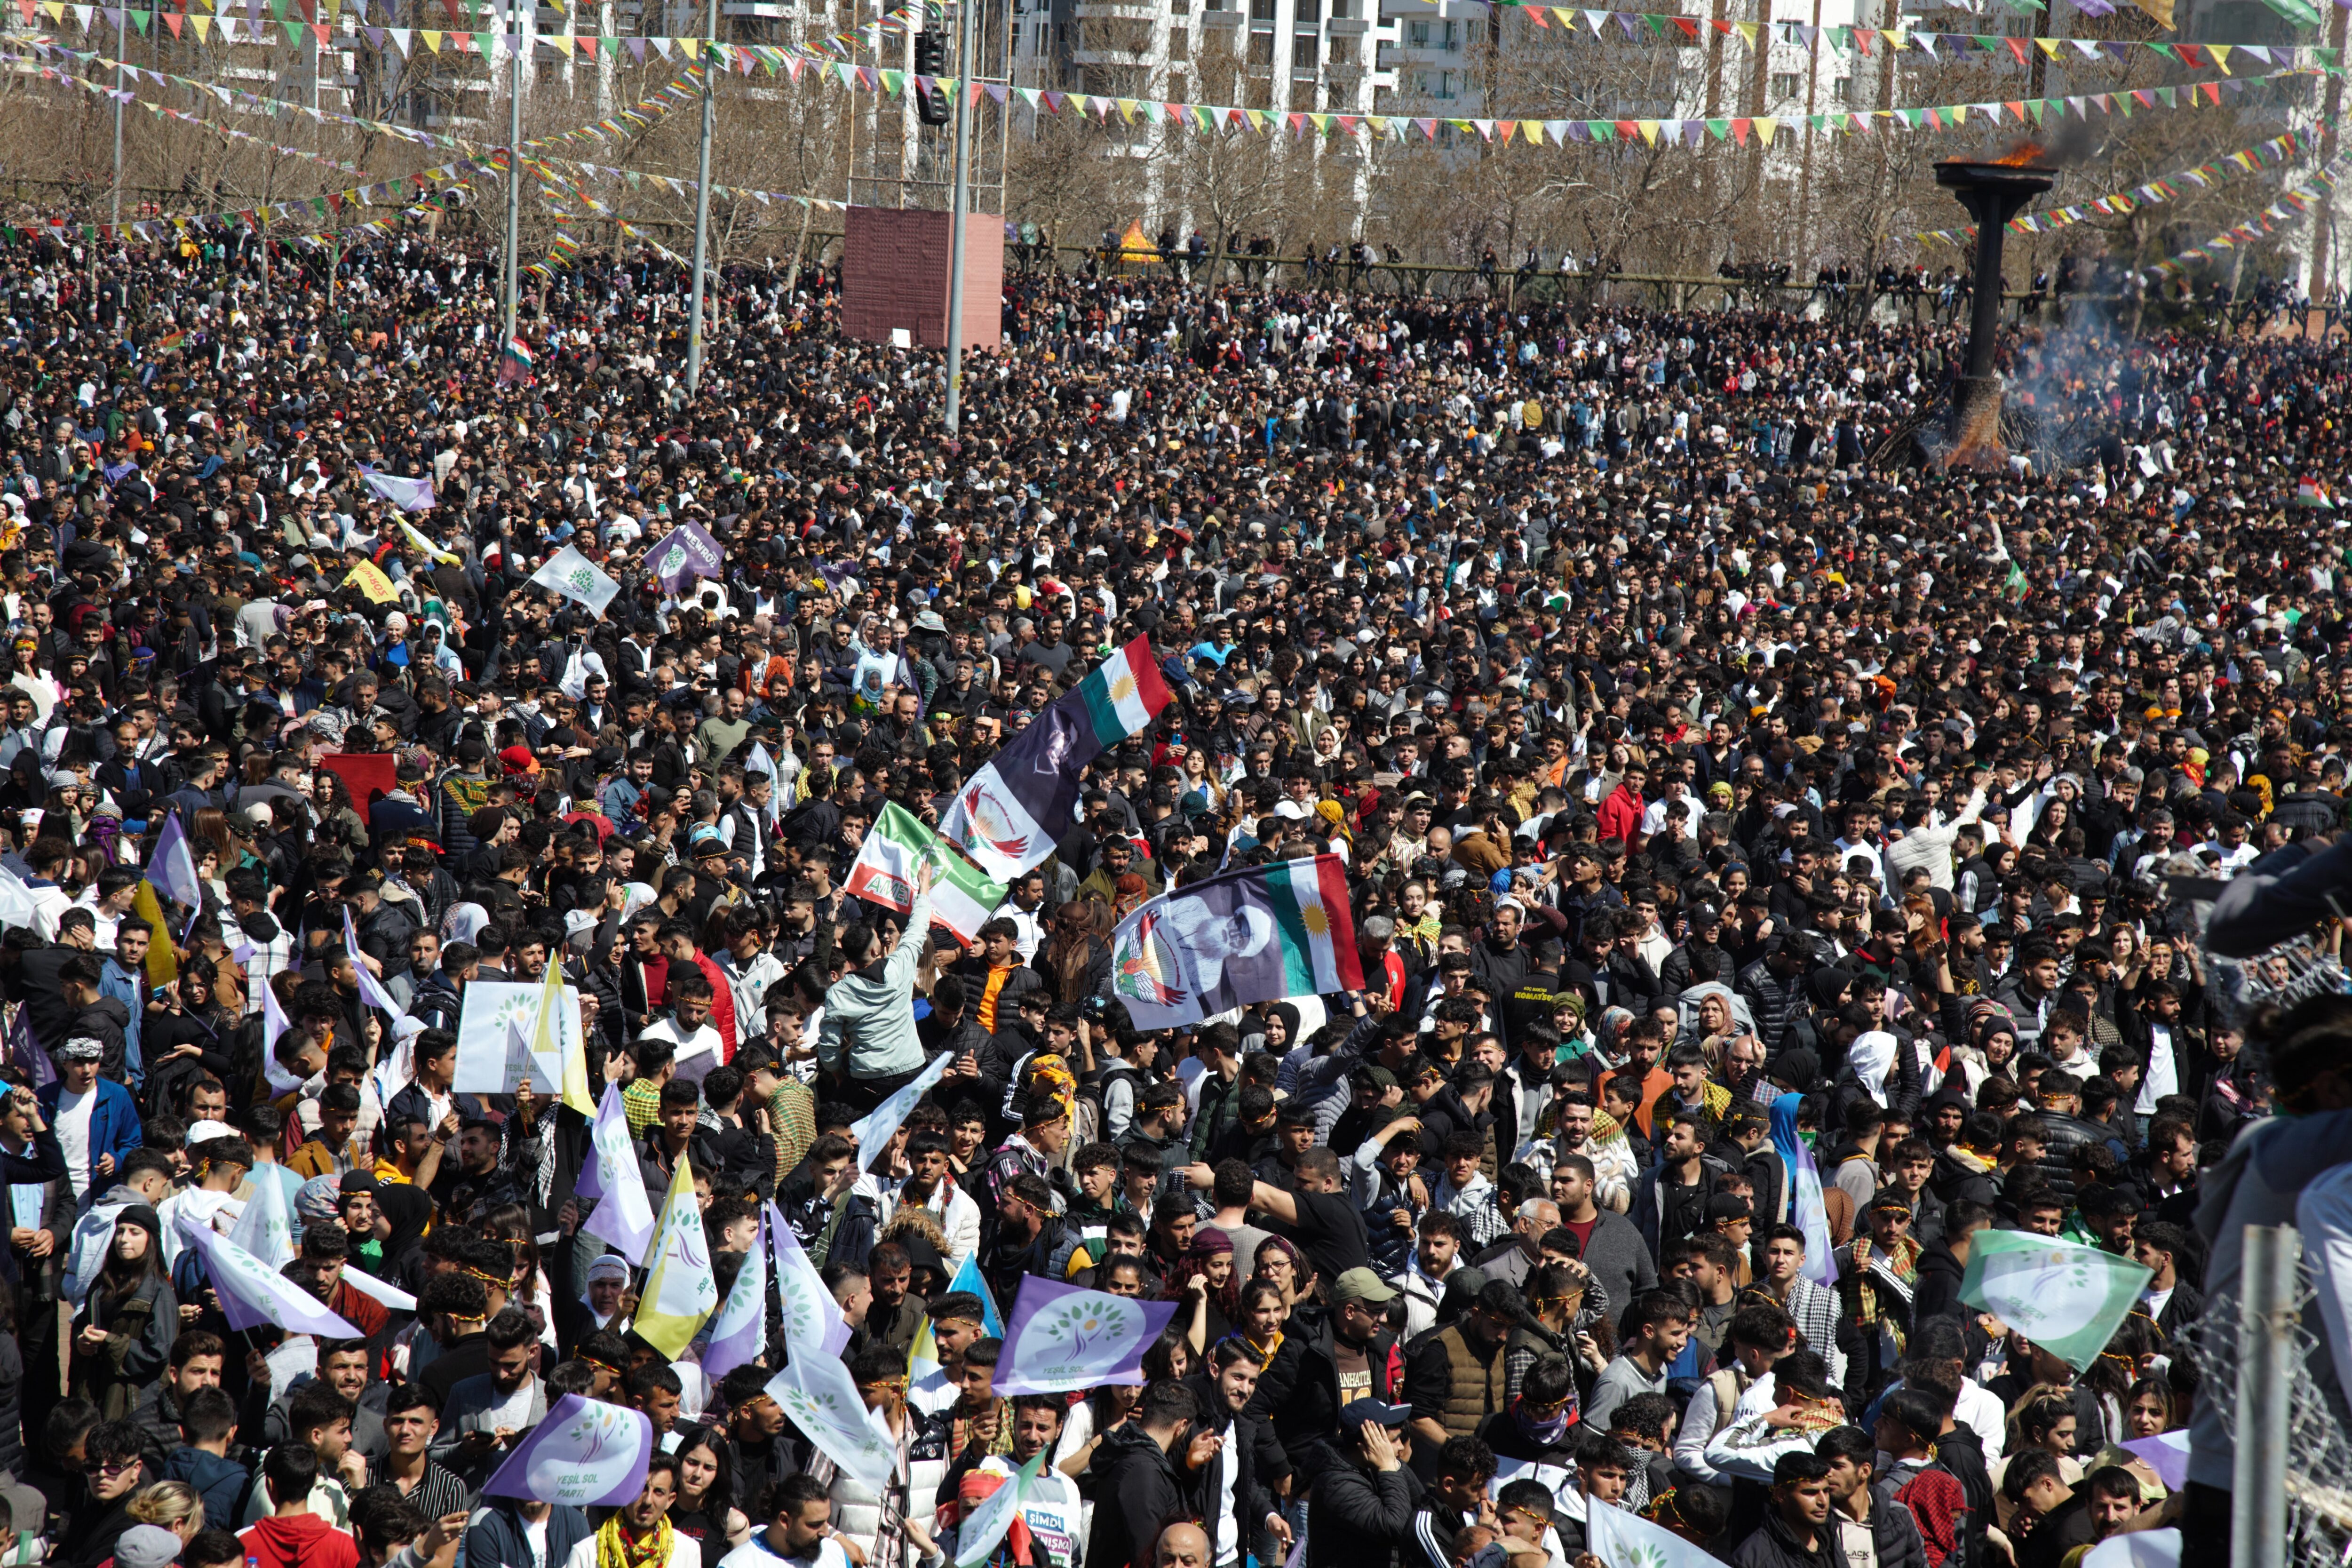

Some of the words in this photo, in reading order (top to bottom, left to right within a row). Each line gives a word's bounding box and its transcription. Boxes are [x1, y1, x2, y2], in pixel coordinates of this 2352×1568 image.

[683, 530, 717, 568] NEWROZ
[1514, 992, 1553, 1001] KOMATSU
[504, 1063, 524, 1073] YEŞİL
[1043, 1365, 1065, 1376] YEŞİL
[1048, 1376, 1076, 1387] PARTİ
[1339, 1370, 1372, 1387] ANHATTA
[556, 1472, 580, 1486] YEŞİL
[582, 1474, 598, 1483] SOL
[556, 1486, 587, 1498] PARTİ
[1029, 1512, 1062, 1529] ŞİMDİ
